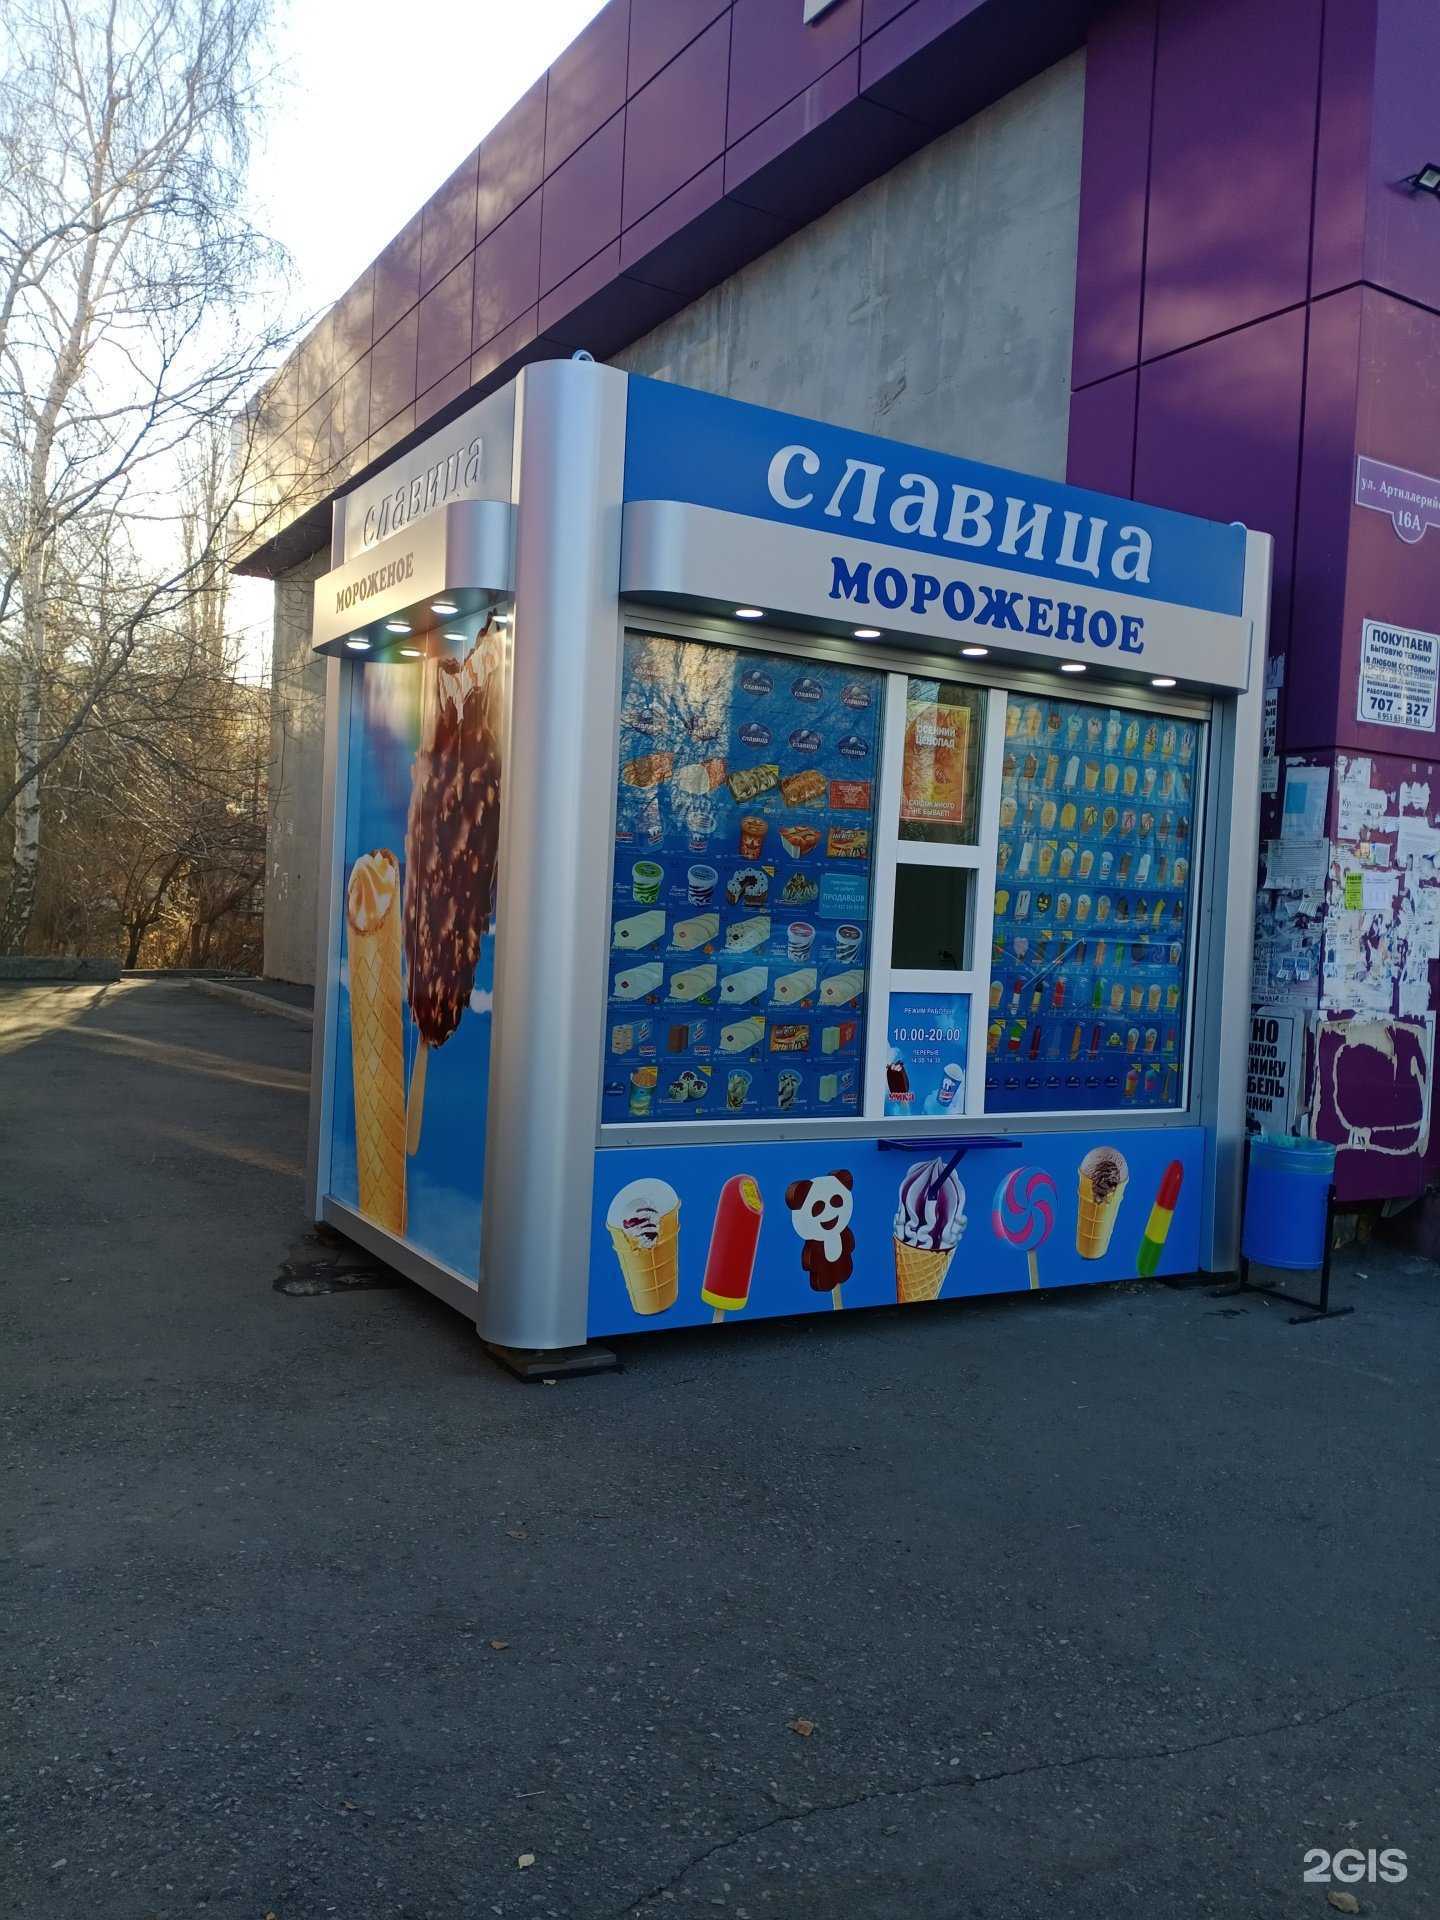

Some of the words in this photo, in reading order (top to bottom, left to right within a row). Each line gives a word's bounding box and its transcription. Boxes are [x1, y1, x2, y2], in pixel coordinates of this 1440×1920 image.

[1361, 478, 1377, 490] ул.
[1380, 480, 1440, 509] Артиллерий
[1398, 510, 1421, 531] 16А
[336, 552, 415, 614] МОРОЖЕНОЕ
[828, 557, 1145, 655] МОРОЖЕНОЕ
[1372, 629, 1433, 653] ПОКУПАЕМ
[1370, 644, 1403, 658] БЫТОВУЮ
[1404, 651, 1431, 663] ТЕХНИКУ
[1372, 657, 1397, 668] ЛЮБОМ
[1370, 697, 1394, 712] 707
[1406, 703, 1428, 717] 327
